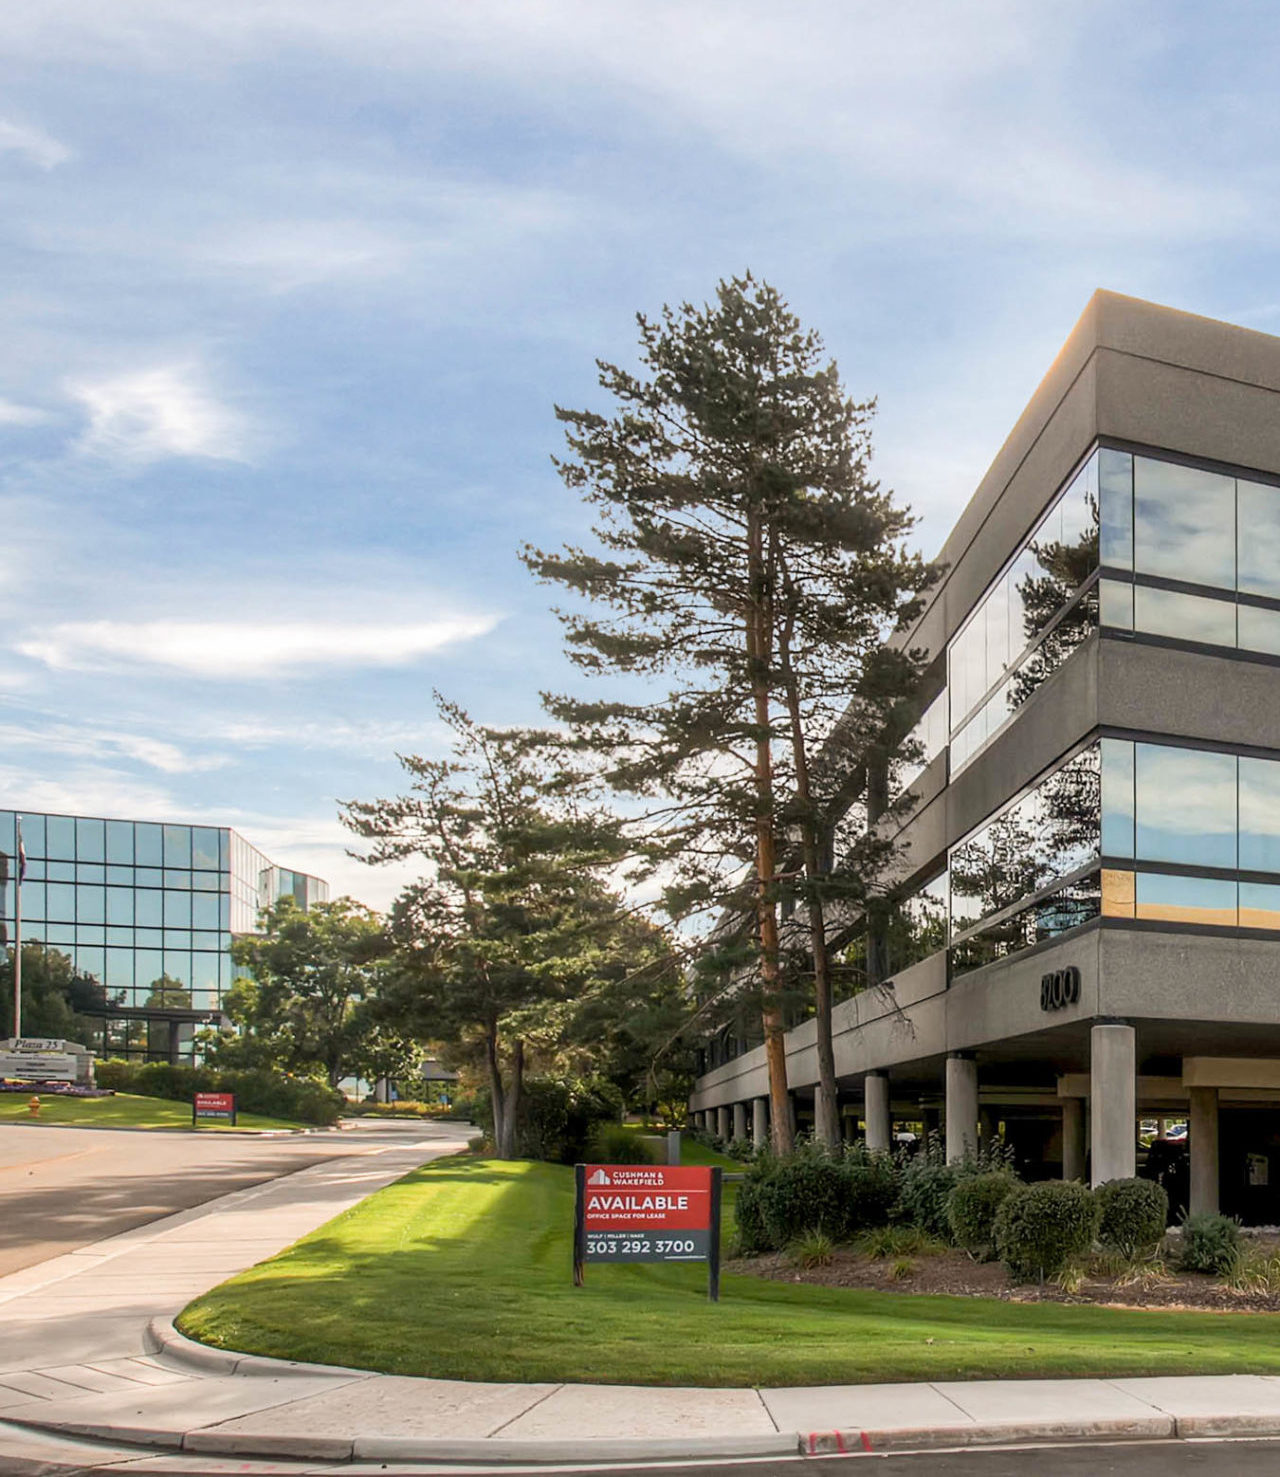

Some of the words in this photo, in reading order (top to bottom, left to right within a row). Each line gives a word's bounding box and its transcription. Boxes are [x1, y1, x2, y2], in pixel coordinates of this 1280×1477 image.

[14, 1039, 43, 1048] Plaza
[46, 1041, 58, 1049] 25
[588, 1196, 688, 1210] AVAILABLE
[587, 1241, 617, 1254] 303
[621, 1241, 651, 1254] 292
[655, 1240, 694, 1253] 3700
